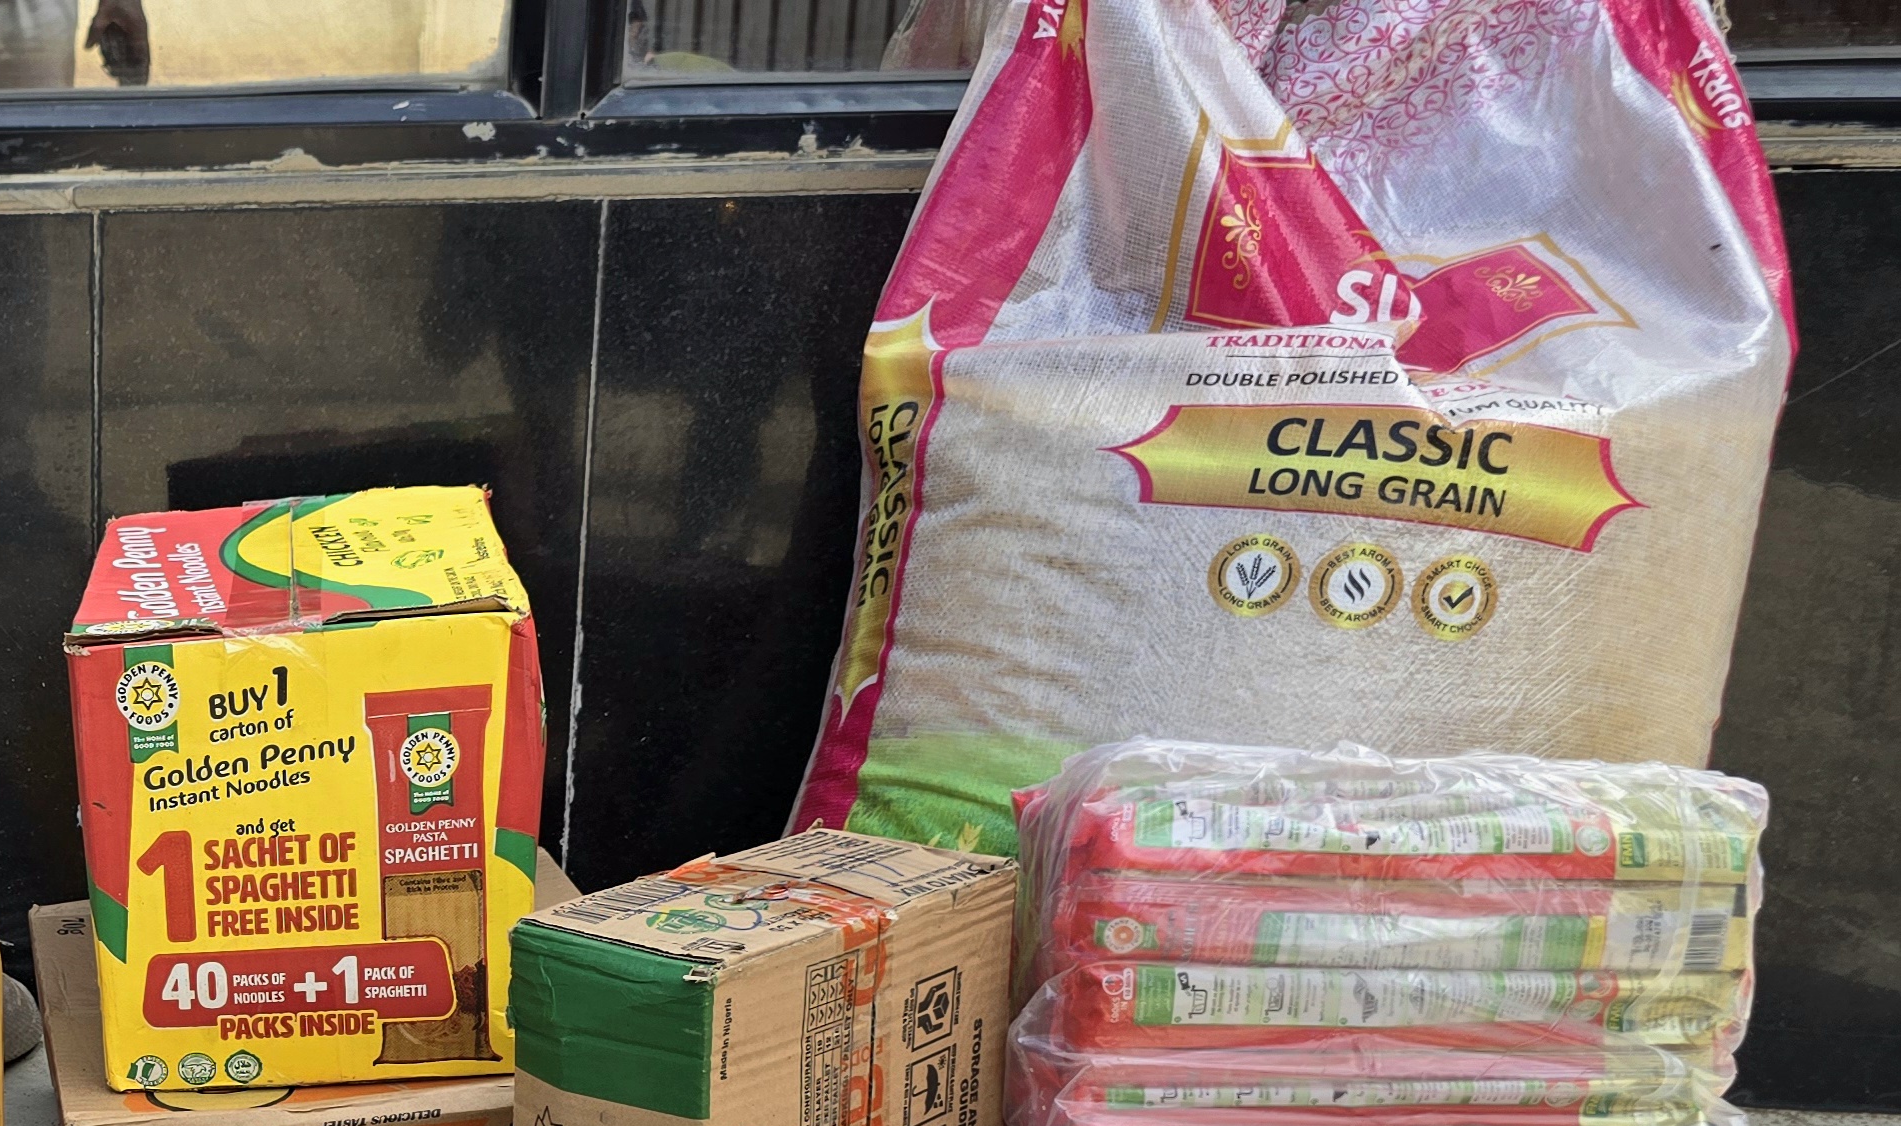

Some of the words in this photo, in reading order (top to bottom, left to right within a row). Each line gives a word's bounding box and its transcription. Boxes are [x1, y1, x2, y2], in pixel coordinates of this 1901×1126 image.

[1688, 39, 1750, 130] SURYA
[1206, 333, 1396, 350] TRADITIONA
[1186, 370, 1279, 388] DOUBLE
[1284, 369, 1399, 387] POLISHED
[1505, 398, 1604, 416] QUALITY
[868, 404, 891, 493] LONG
[1266, 417, 1513, 475] CLASSIC
[870, 401, 919, 599] CLASSIC
[1247, 467, 1364, 501] LONG
[1378, 475, 1507, 517] GRAIN
[112, 526, 167, 569] Penny
[166, 542, 214, 584] Noodles
[309, 525, 364, 567] CHICKEN
[1227, 537, 1259, 557] LONG
[1262, 537, 1293, 562] GRAIN
[1327, 548, 1356, 570] BEST
[1359, 548, 1395, 575] AROMA
[1219, 587, 1245, 609] LONG
[1246, 591, 1282, 610] GRAIN
[1320, 598, 1346, 621] BEST
[1345, 604, 1386, 622] AROMA
[118, 664, 147, 703] GOLDEN
[150, 664, 178, 700] PENNY
[208, 683, 269, 721] BUY
[272, 666, 289, 707] 1
[129, 709, 170, 725] FOODS
[209, 718, 270, 744] carton
[273, 709, 295, 732] of
[143, 753, 249, 792] Golden
[260, 735, 356, 769] Penny
[402, 732, 428, 765] GOLDEN
[432, 732, 456, 761] PENNY
[149, 785, 220, 813] Instant
[226, 768, 311, 800] Noodles
[411, 769, 447, 783] FOODS
[235, 820, 266, 837] and
[269, 817, 296, 839] get
[385, 821, 436, 834] GOLDEN
[438, 817, 477, 830] PENNY
[413, 831, 449, 843] PASTA
[204, 832, 312, 871] SACHET
[318, 831, 356, 864] OF
[384, 842, 478, 865] SPAGHETTI
[1619, 832, 1634, 867] FMN
[136, 829, 198, 944] 1
[205, 866, 358, 905] SPAGHETTI
[206, 906, 273, 938] FREE
[276, 902, 360, 934] INSIDE
[161, 960, 228, 1012] 40
[233, 973, 269, 989] PACKS
[270, 970, 287, 986] OF
[364, 967, 397, 982] PACK
[398, 965, 415, 980] OF
[364, 983, 428, 999] SPAGHETTI
[233, 987, 286, 1004] NOODLES
[219, 1015, 296, 1041] PACKS
[298, 1011, 376, 1037] INSIDE
[721, 997, 733, 1045] Nigeria
[720, 1057, 729, 1081] Made
[969, 1018, 982, 1104] STORAGE
[804, 1035, 813, 1123] CONFIGURATION
[815, 1077, 823, 1112] LAYER
[370, 1108, 441, 1126] DELICIOUS
